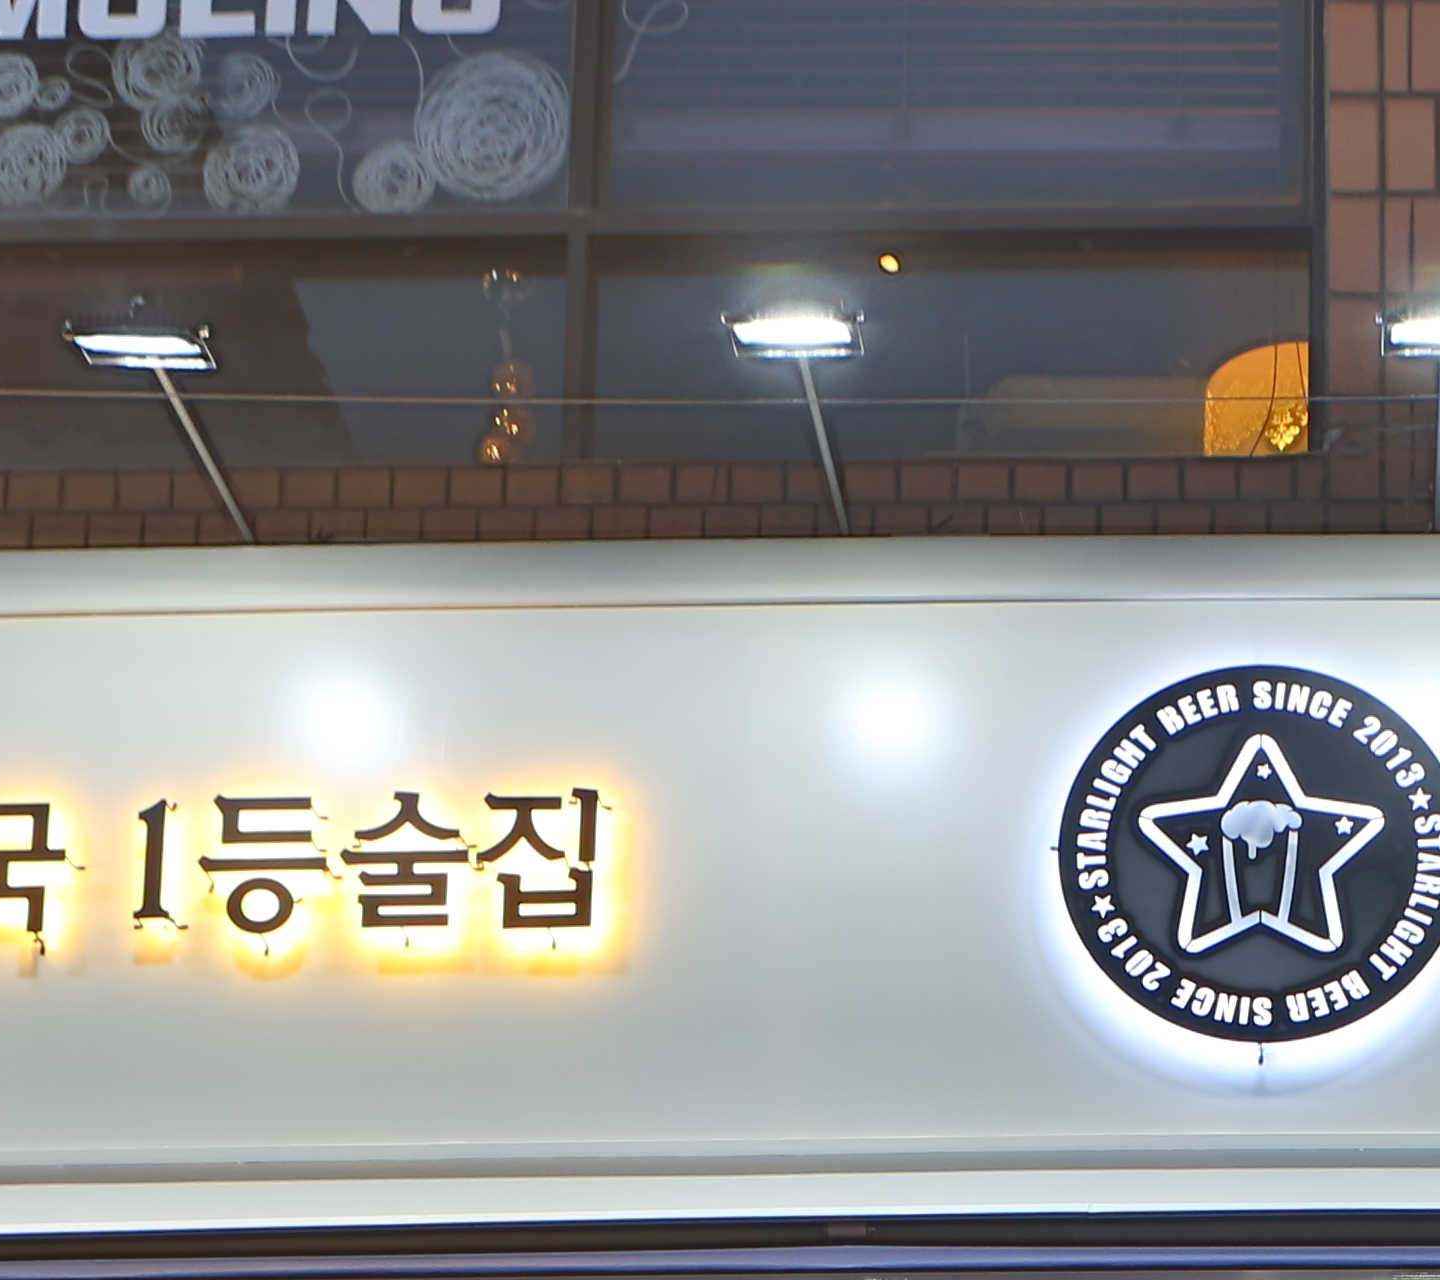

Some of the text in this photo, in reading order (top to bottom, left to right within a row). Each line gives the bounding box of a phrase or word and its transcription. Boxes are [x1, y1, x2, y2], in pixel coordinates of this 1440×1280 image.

[1076, 680, 1424, 891] STARLIGHT BEER SINCE 2013
[134, 787, 606, 942] 1등술집
[1095, 923, 1170, 991] 2013
[1171, 979, 1272, 1026] SINCE
[1286, 970, 1369, 1024] BEER
